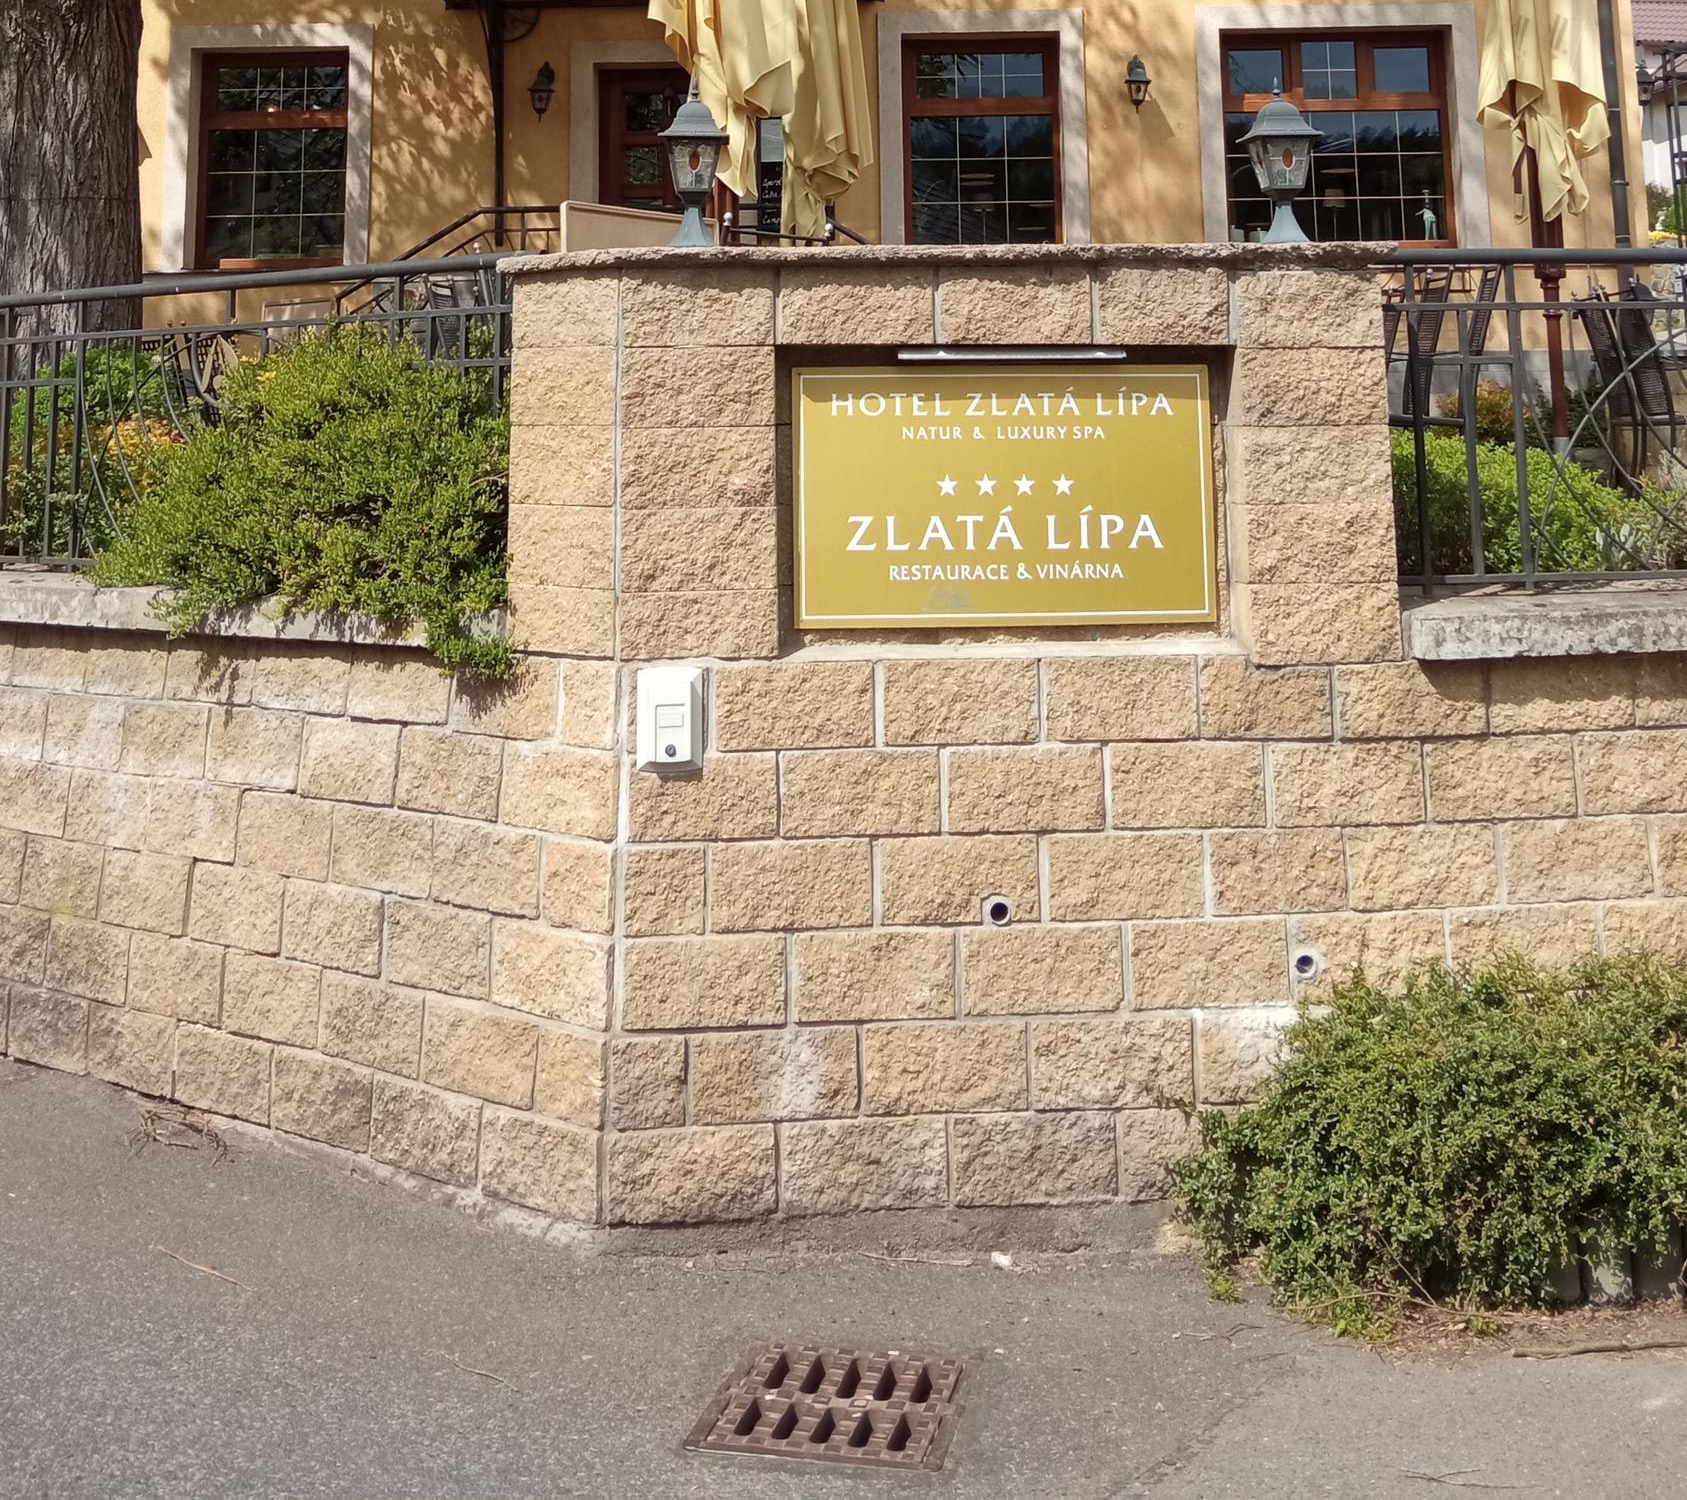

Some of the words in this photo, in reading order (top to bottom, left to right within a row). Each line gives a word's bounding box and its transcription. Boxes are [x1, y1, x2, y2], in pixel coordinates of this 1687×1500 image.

[830, 393, 951, 417] HOTEL
[965, 386, 1081, 417] ZLATÁ
[1096, 386, 1174, 416] LÍPA
[902, 426, 963, 440] NATUR
[973, 427, 985, 439] &
[997, 426, 1067, 440] LUXURY
[1073, 426, 1105, 439] SPA
[846, 505, 1022, 551] ZLATÁ
[1046, 505, 1164, 549] LÍPA
[889, 564, 1009, 581] RESTAURACE
[1017, 563, 1033, 580] &
[1036, 560, 1124, 579] VINÁRNA
